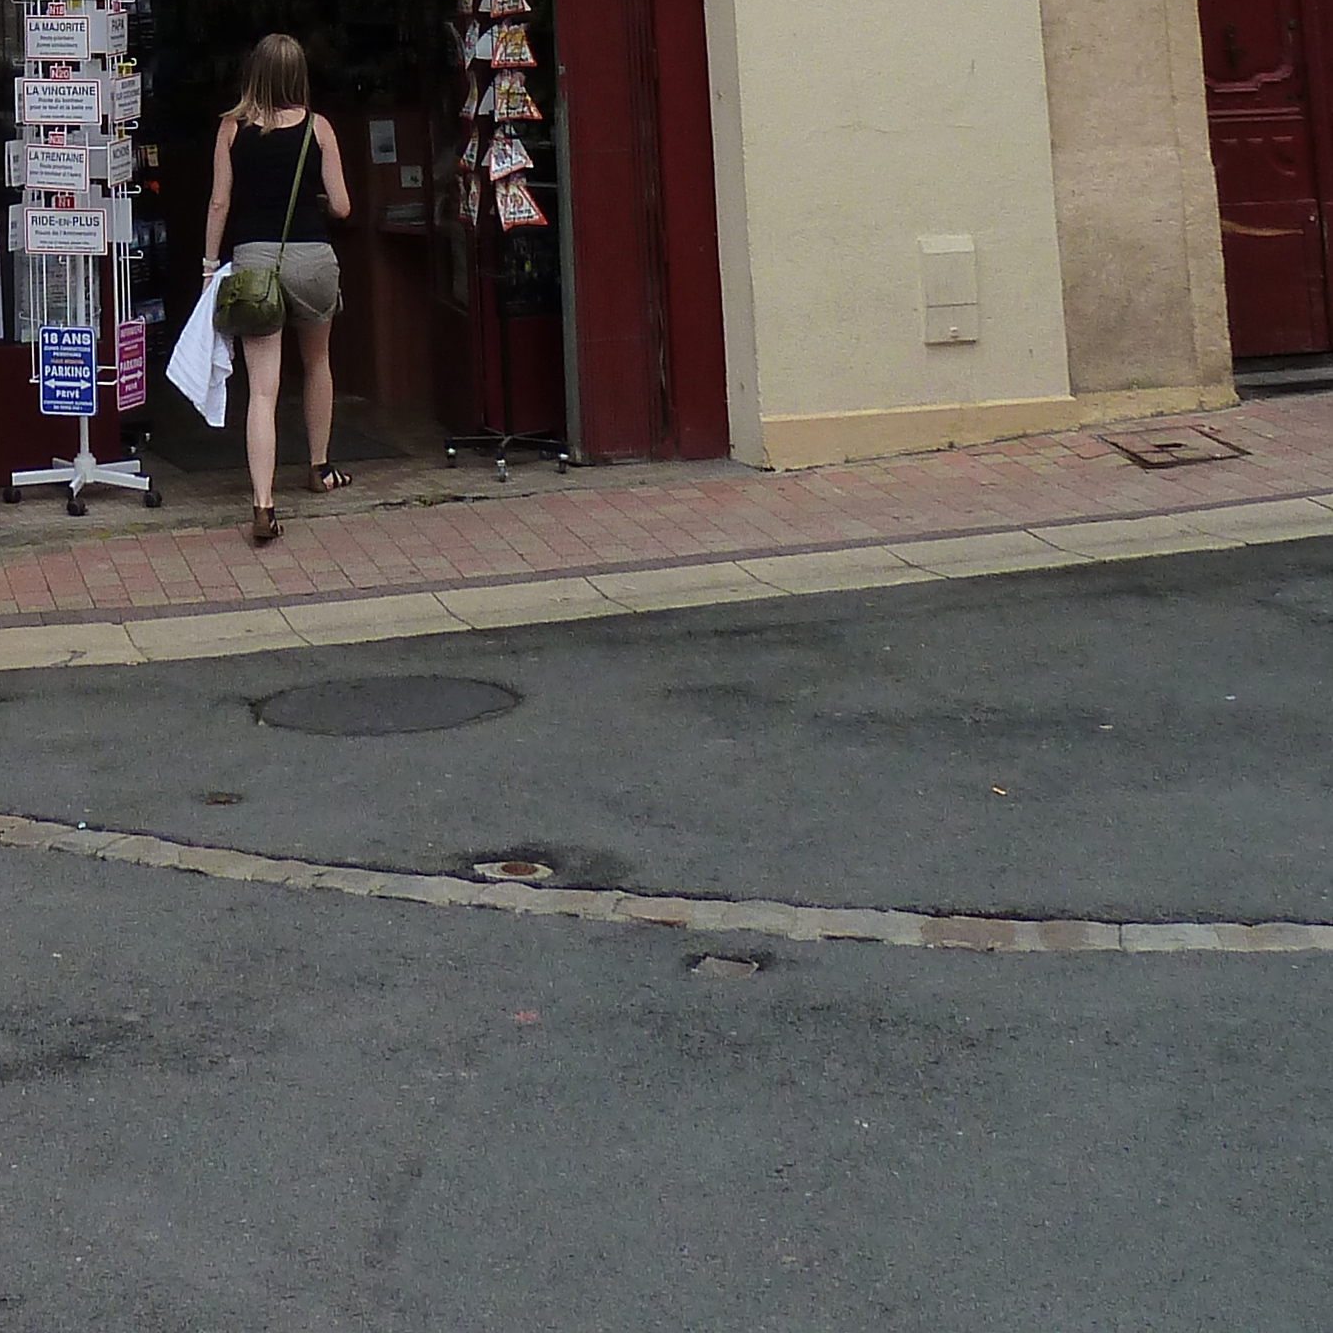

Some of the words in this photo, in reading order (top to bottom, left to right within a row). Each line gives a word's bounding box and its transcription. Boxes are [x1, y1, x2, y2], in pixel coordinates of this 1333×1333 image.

[29, 22, 40, 32] LA
[42, 21, 86, 32] MAJORITÉ
[51, 69, 69, 78] N20
[26, 86, 39, 96] LA
[42, 86, 96, 96] VINGTAINE
[29, 151, 39, 161] LA
[41, 151, 84, 163] TRENTAINE
[31, 215, 100, 227] RIDE-EN-PLUS
[43, 332, 59, 345] 18
[62, 333, 91, 346] ANS
[44, 366, 91, 379] PARKING
[55, 389, 80, 399] PRIVÉ
